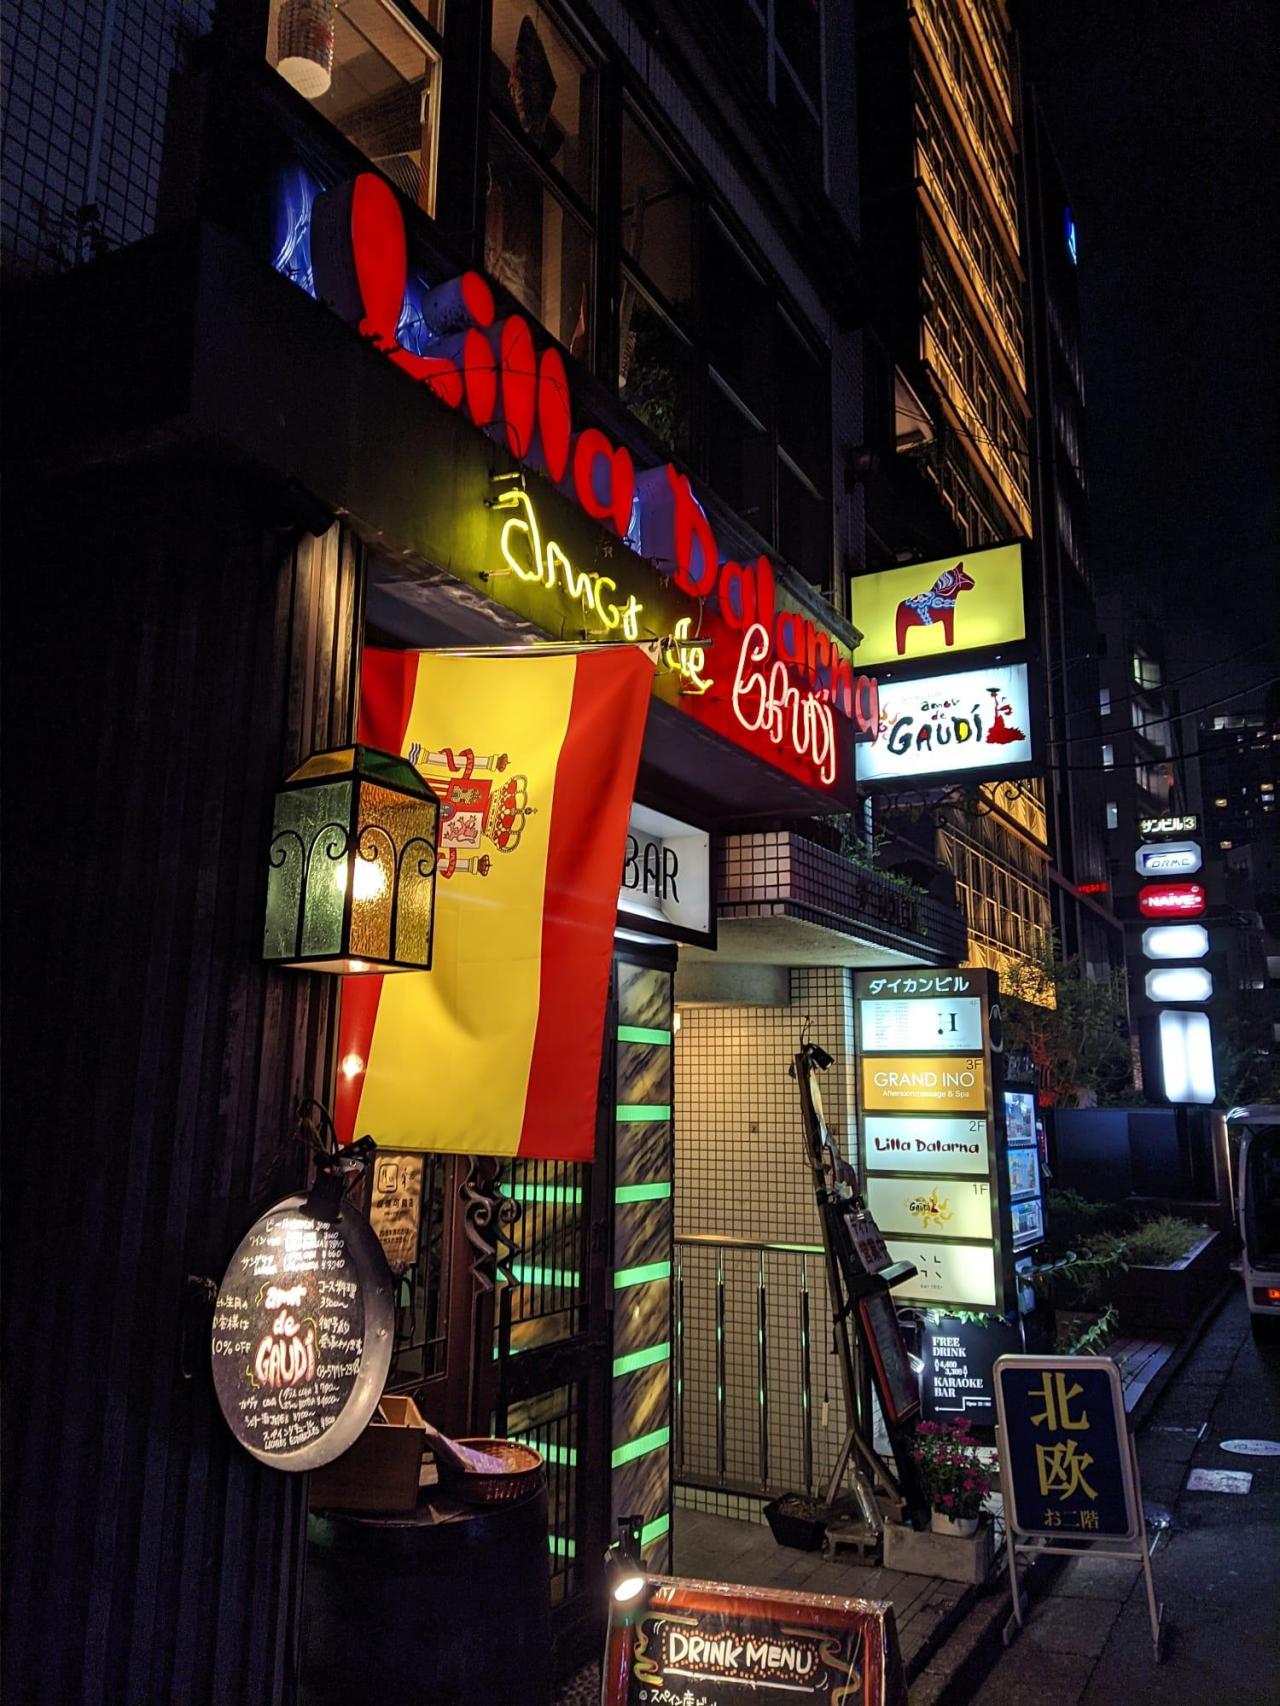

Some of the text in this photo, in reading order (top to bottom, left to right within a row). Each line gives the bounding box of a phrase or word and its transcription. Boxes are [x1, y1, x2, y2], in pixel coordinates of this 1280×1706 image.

[351, 172, 880, 746] Lilla Dalarna
[665, 617, 714, 690] de
[931, 711, 946, 720] de
[622, 834, 680, 903] BAR
[869, 976, 970, 995] ダイカンビル
[966, 1059, 984, 1070] 3F
[874, 1072, 975, 1087] GRAND INO
[955, 1090, 969, 1098] Spa
[969, 1120, 985, 1132] 2F
[874, 1137, 980, 1154] Lilla Dalarna
[973, 1183, 989, 1195] 1F
[273, 1309, 301, 1338] de
[932, 1336, 960, 1347] FREE
[932, 1347, 967, 1358] DRINK
[933, 1376, 984, 1389] KARAOKE
[934, 1387, 956, 1398] BAR
[1027, 1372, 1099, 1501] 北欧
[1043, 1508, 1099, 1530] お二階
[669, 1632, 813, 1675] DRINK MENU
